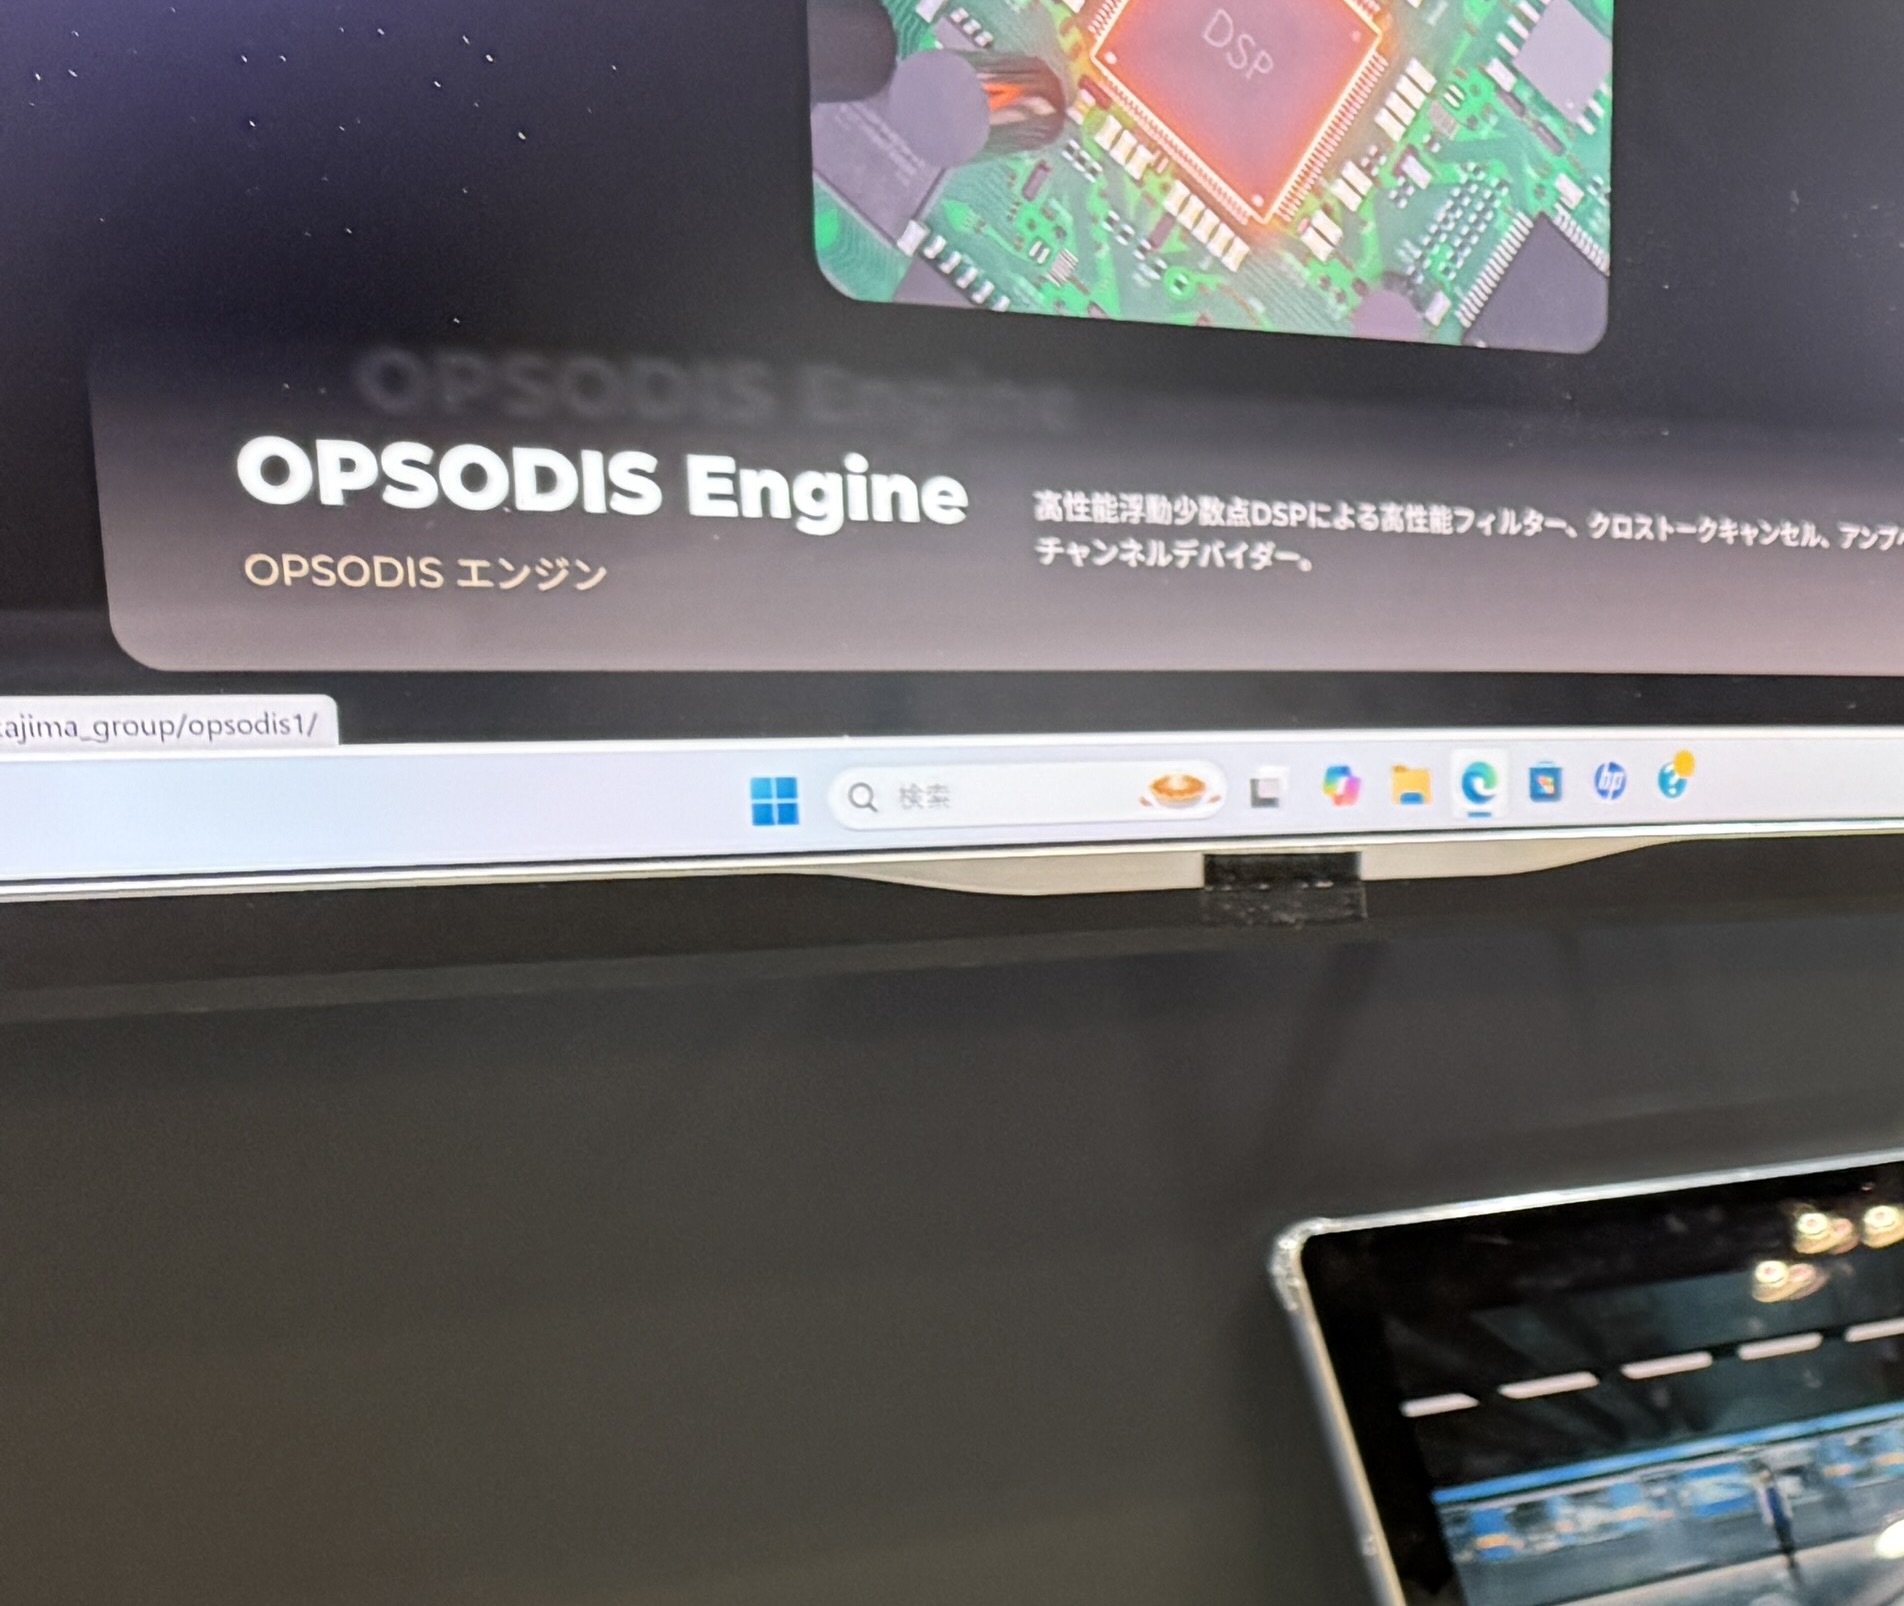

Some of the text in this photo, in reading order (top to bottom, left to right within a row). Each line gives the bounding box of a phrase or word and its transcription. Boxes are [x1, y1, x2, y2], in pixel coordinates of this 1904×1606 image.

[1203, 9, 1274, 79] DSP
[236, 435, 969, 535] OPSODIS Engine
[244, 553, 607, 591] OPSODIS エンジン
[0, 711, 318, 744] ajima_group/opsodis1/
